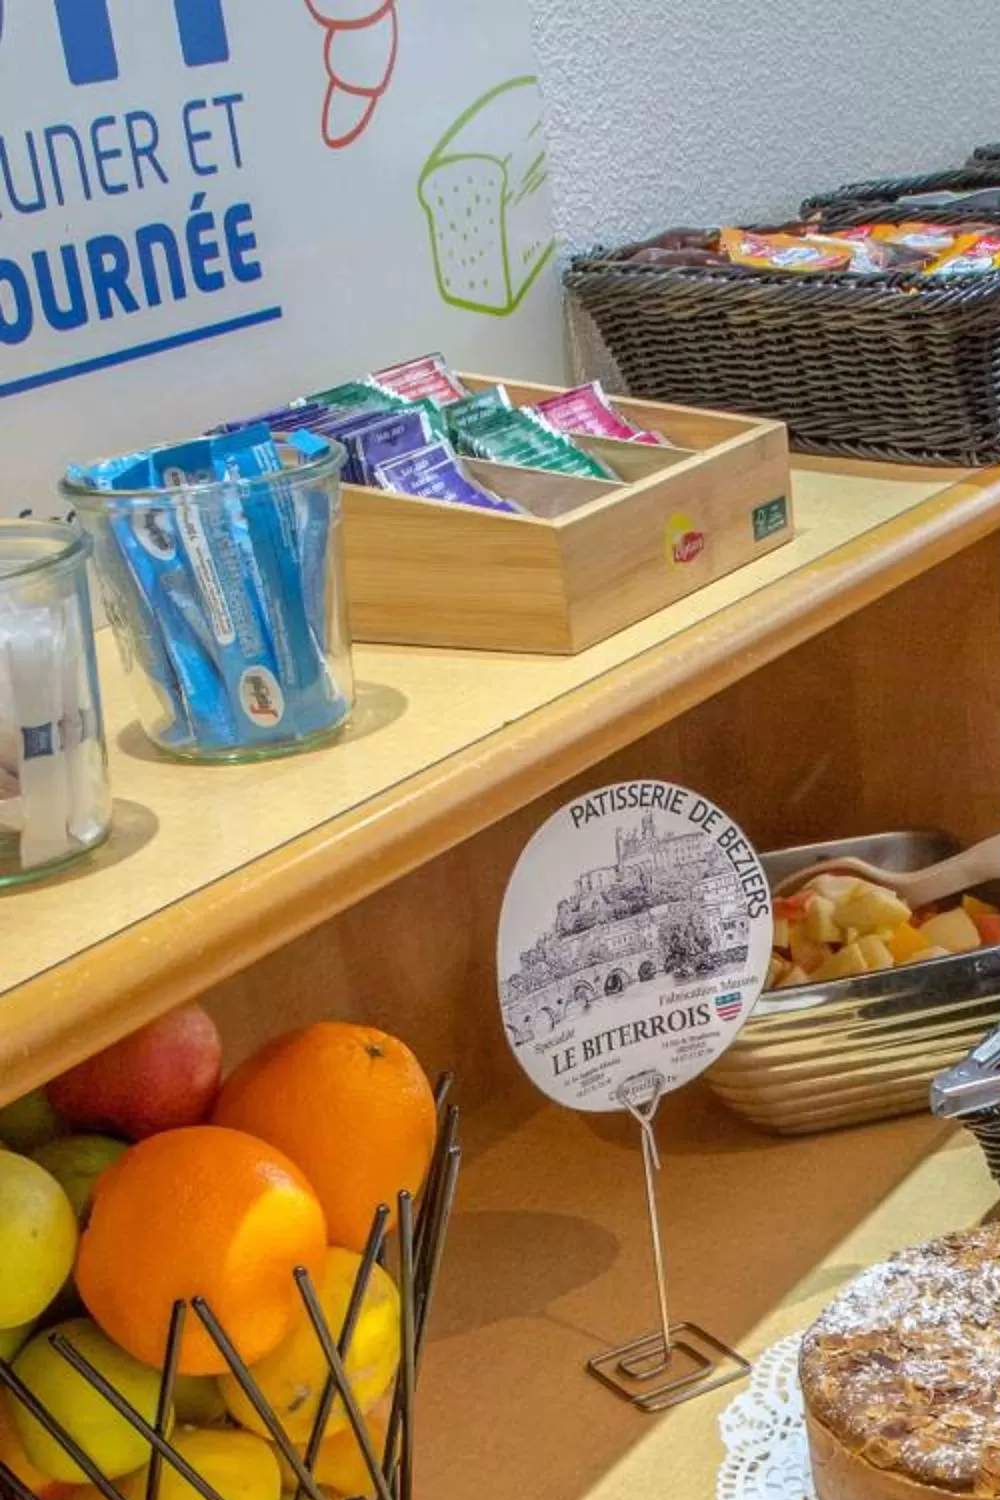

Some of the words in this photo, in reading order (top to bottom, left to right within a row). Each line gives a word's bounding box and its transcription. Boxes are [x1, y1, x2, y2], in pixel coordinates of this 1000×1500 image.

[183, 93, 244, 176] ET
[570, 784, 689, 828] PATISSERIE
[688, 800, 723, 834] DE
[717, 826, 769, 919] BEZIERS
[552, 1046, 577, 1076] LE
[582, 1003, 712, 1062] BITERROIS
